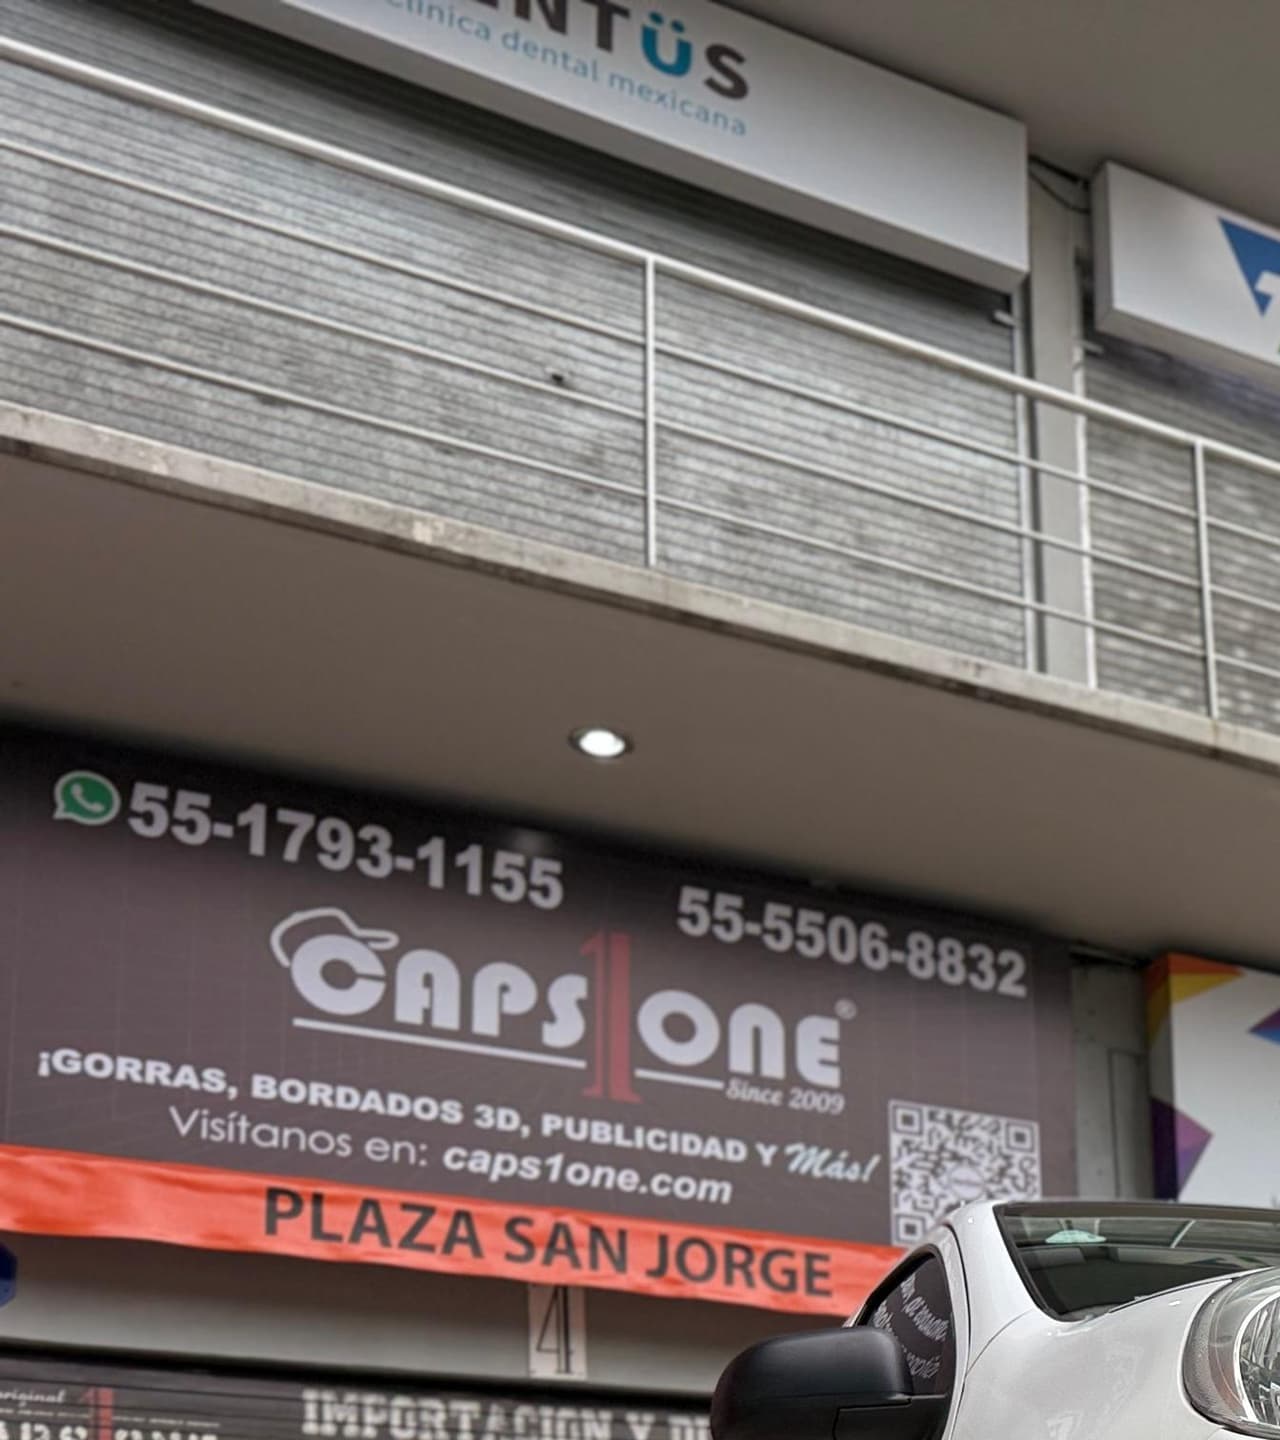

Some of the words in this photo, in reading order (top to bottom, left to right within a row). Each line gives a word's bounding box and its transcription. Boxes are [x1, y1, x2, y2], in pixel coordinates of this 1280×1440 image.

[501, 30, 600, 82] dental
[608, 73, 746, 136] mexicana
[128, 781, 564, 909] 55-1793-1155
[677, 885, 1028, 998] 55-5506-8832
[38, 1048, 238, 1100] ¡GORRAS,
[251, 1074, 464, 1125] BORDADOS
[475, 1102, 530, 1139] 3D,
[541, 1112, 747, 1163] PUBLICIDAD
[755, 1142, 779, 1167] Y
[783, 1142, 881, 1183] Más!
[726, 1078, 783, 1107] Since
[788, 1087, 845, 1115] 2009
[169, 1104, 353, 1158] Visítanos
[364, 1136, 428, 1166] en:
[442, 1146, 733, 1205] caps1one.com
[264, 1186, 486, 1259] PLAZA
[503, 1215, 629, 1276] SAN
[645, 1233, 833, 1298] JORGE
